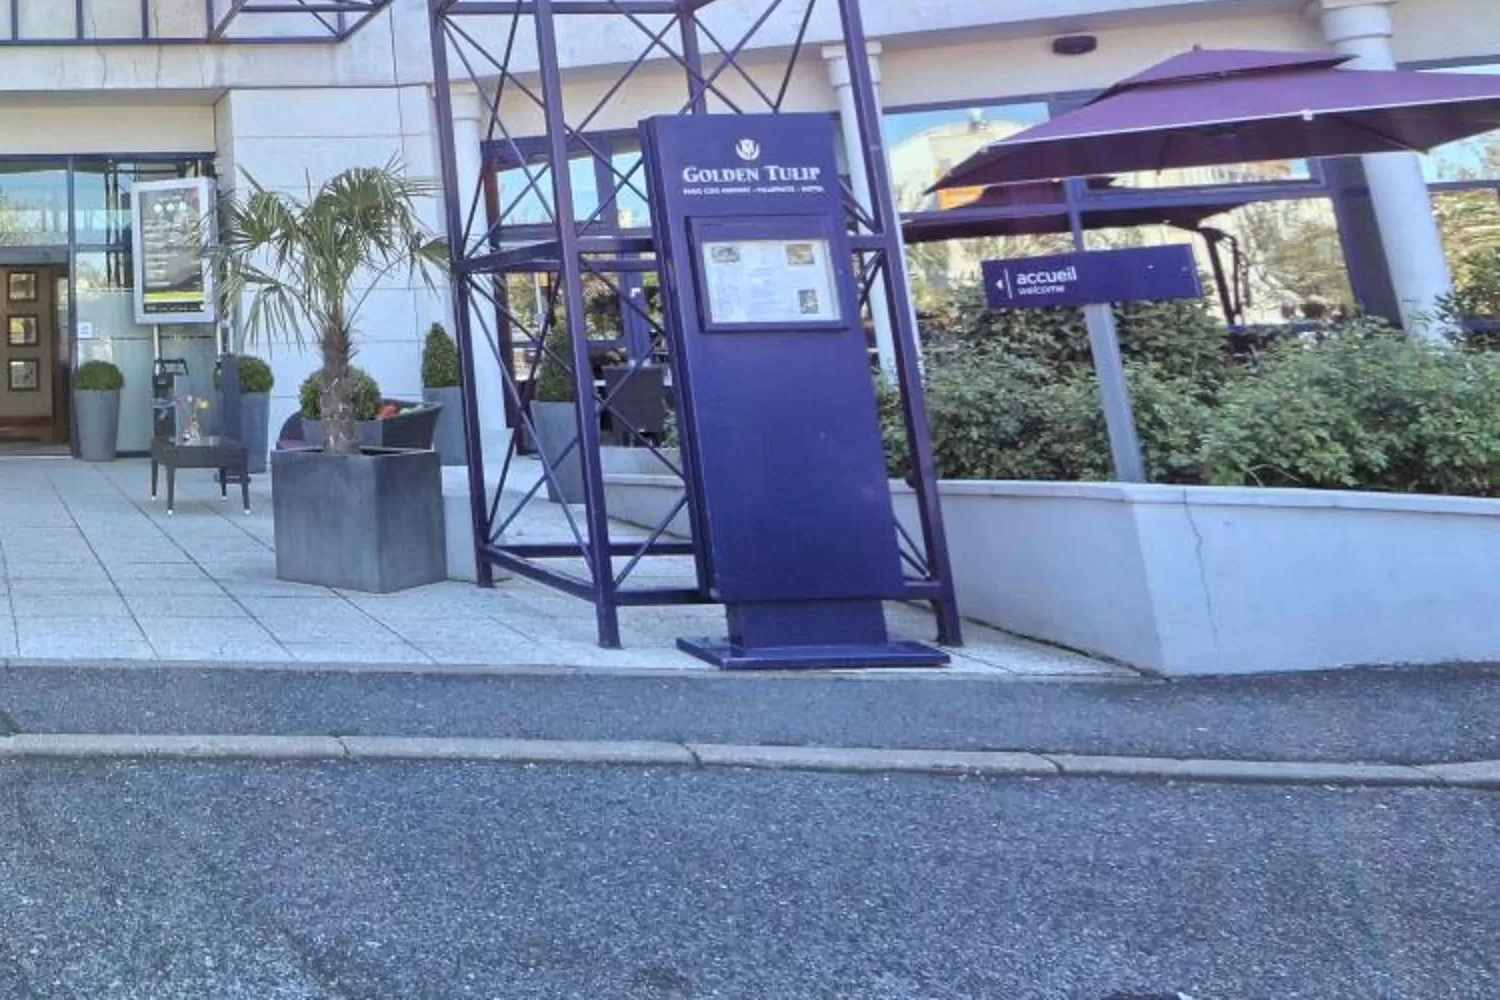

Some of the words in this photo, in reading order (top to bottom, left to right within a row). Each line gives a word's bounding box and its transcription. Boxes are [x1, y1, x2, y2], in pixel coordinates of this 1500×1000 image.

[682, 166, 759, 183] GOLDEN
[763, 165, 821, 181] TULIP
[1016, 265, 1077, 285] accueil
[1017, 284, 1065, 296] welcome
